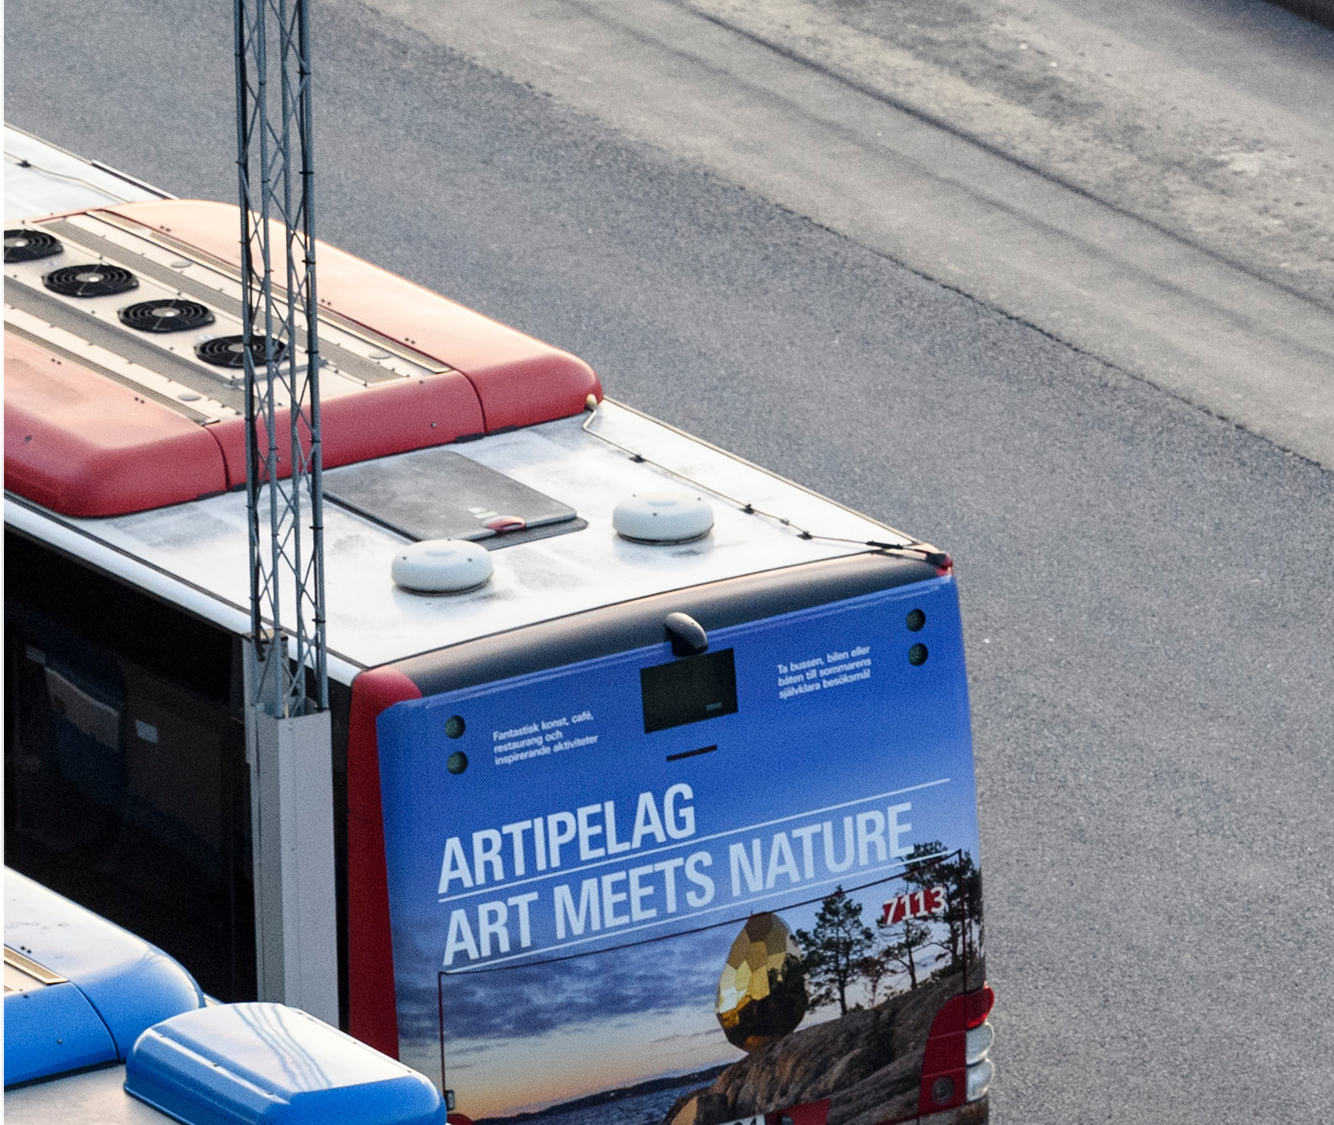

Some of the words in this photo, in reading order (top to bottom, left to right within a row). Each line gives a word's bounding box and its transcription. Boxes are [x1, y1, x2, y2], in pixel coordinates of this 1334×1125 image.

[777, 664, 788, 674] Ta
[790, 657, 824, 672] bussen,
[827, 651, 849, 663] bilen
[851, 646, 871, 657] eller
[778, 673, 804, 687] båten
[806, 669, 817, 680] till
[819, 658, 872, 677] sommarens
[779, 682, 821, 700] självklara
[823, 668, 871, 688] besöksmål
[493, 723, 539, 741] Fantastisk
[541, 717, 569, 730] konst,
[571, 709, 594, 723] café,
[494, 736, 543, 753] restaurang
[545, 730, 563, 741] och
[495, 746, 551, 765] inspirerande
[553, 735, 599, 752] aktiviteter
[438, 783, 696, 894] ARTIPELAG
[443, 891, 538, 966] ART
[553, 851, 715, 940] MEETS
[728, 802, 915, 897] NATURE
[883, 886, 946, 925] 7113
